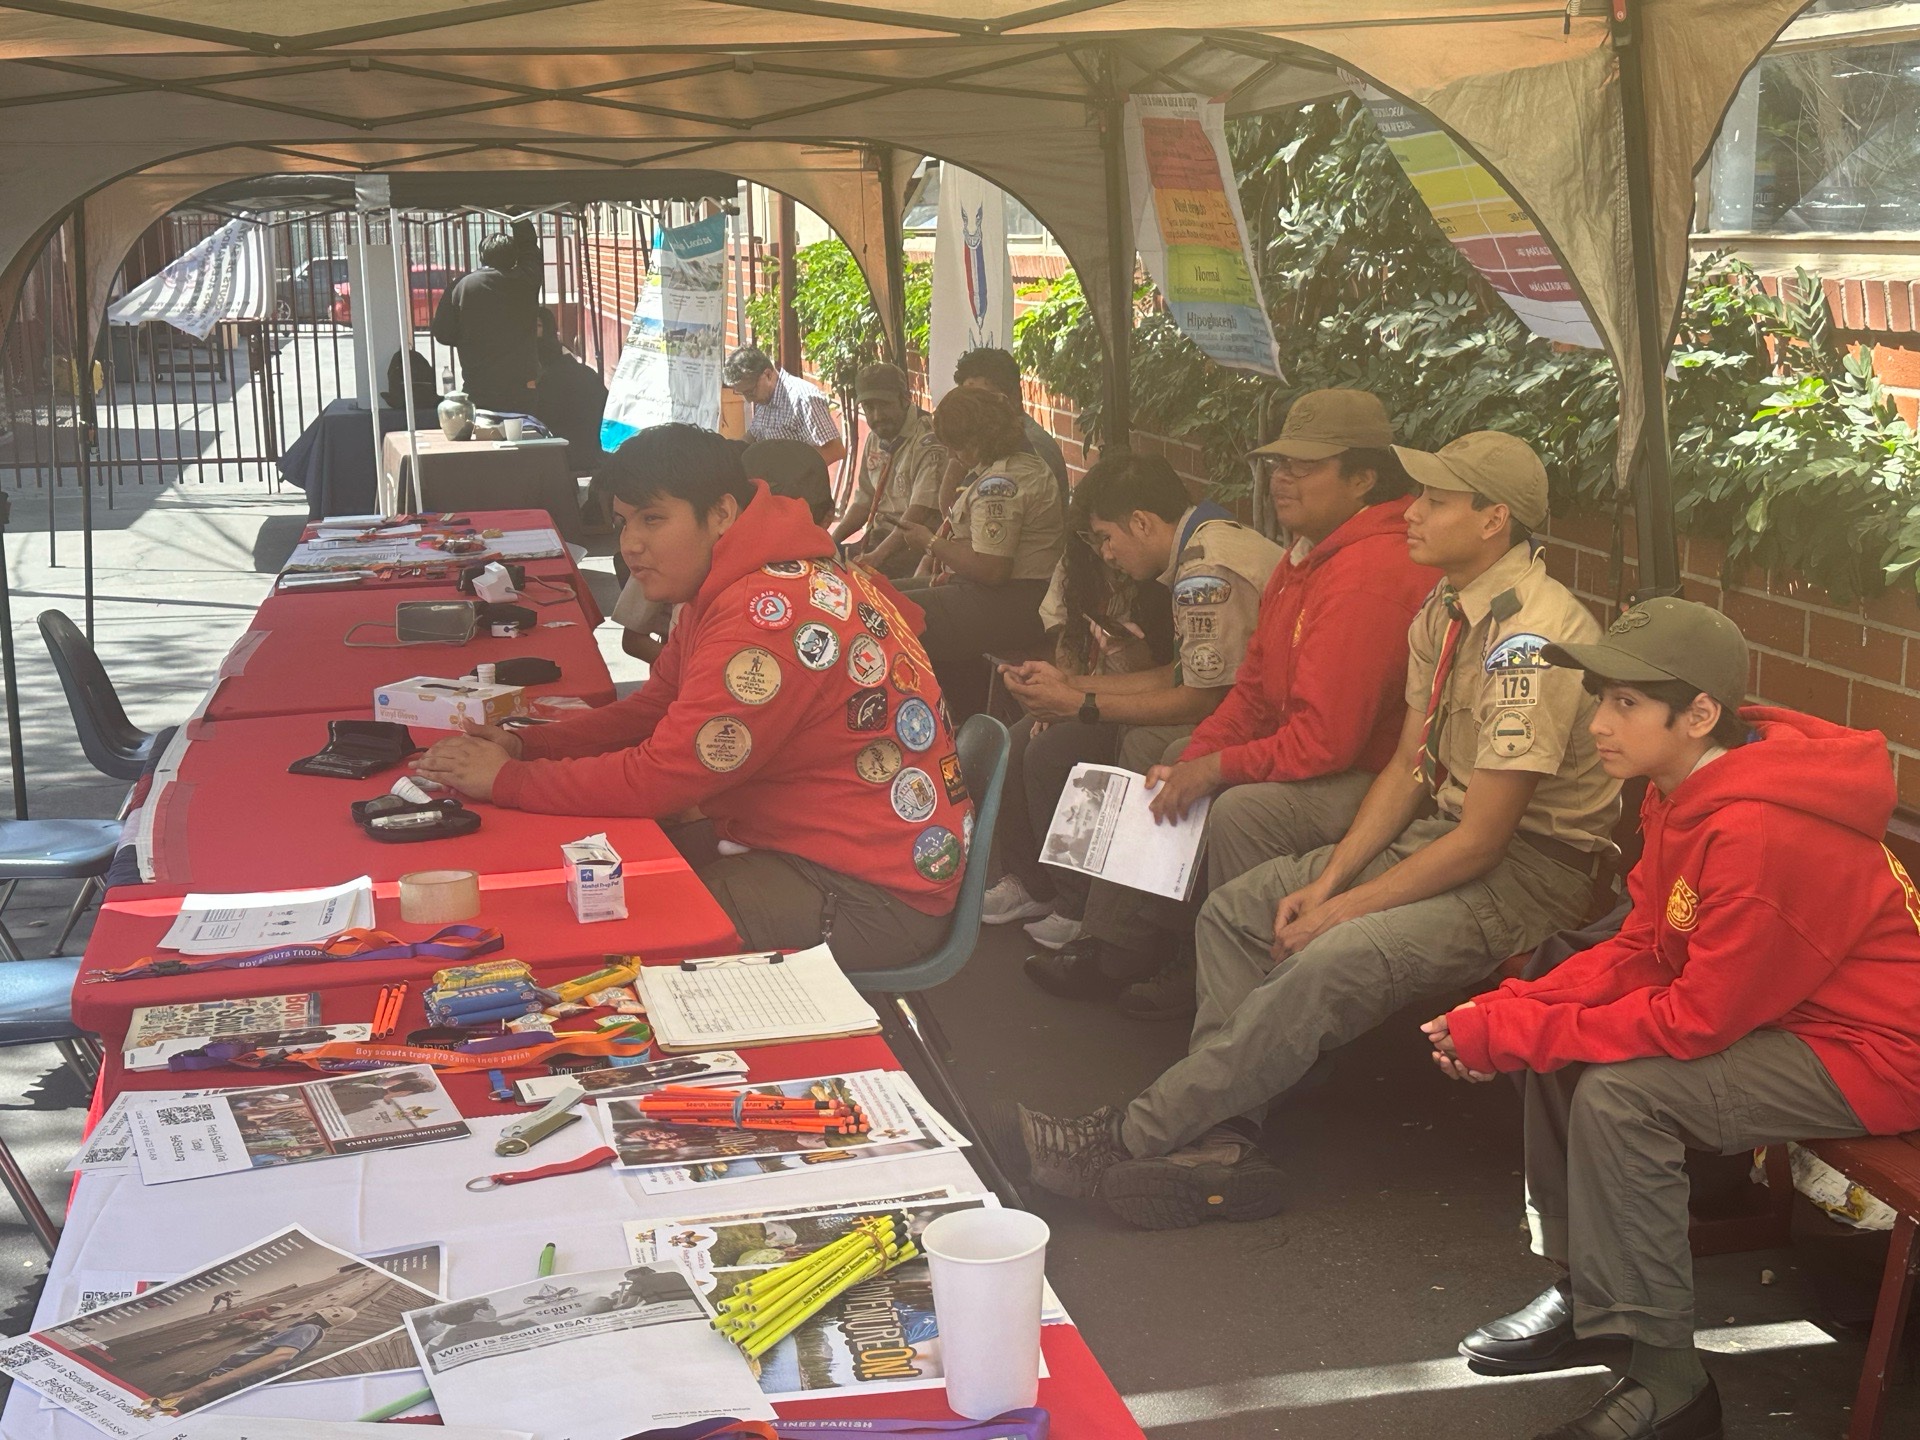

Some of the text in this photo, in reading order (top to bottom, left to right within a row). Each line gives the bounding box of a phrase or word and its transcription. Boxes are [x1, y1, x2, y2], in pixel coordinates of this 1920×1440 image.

[1195, 266, 1221, 282] Normal
[988, 503, 1003, 516] 179
[1189, 618, 1213, 633] 179
[1502, 676, 1530, 698] 179
[380, 710, 419, 721] Vinyl Gloves
[239, 960, 257, 968] BOY
[212, 1007, 255, 1034] Scout
[356, 1047, 372, 1057] Boy
[374, 1048, 407, 1057] scouts
[500, 1052, 531, 1064] parish
[556, 1067, 573, 1075] YOU
[535, 1302, 583, 1316] SCOUTS
[844, 1280, 904, 1351] ADVENTURE
[439, 1341, 480, 1358] What
[499, 1325, 551, 1342] Scouts
[553, 1316, 593, 1331] BSA?
[860, 1348, 919, 1379] ON!
[42, 1356, 61, 1372] Find
[64, 1370, 99, 1393] Scouting
[97, 1387, 116, 1403] Unit
[782, 1420, 816, 1428] INES
[820, 1420, 873, 1429] PARISH
